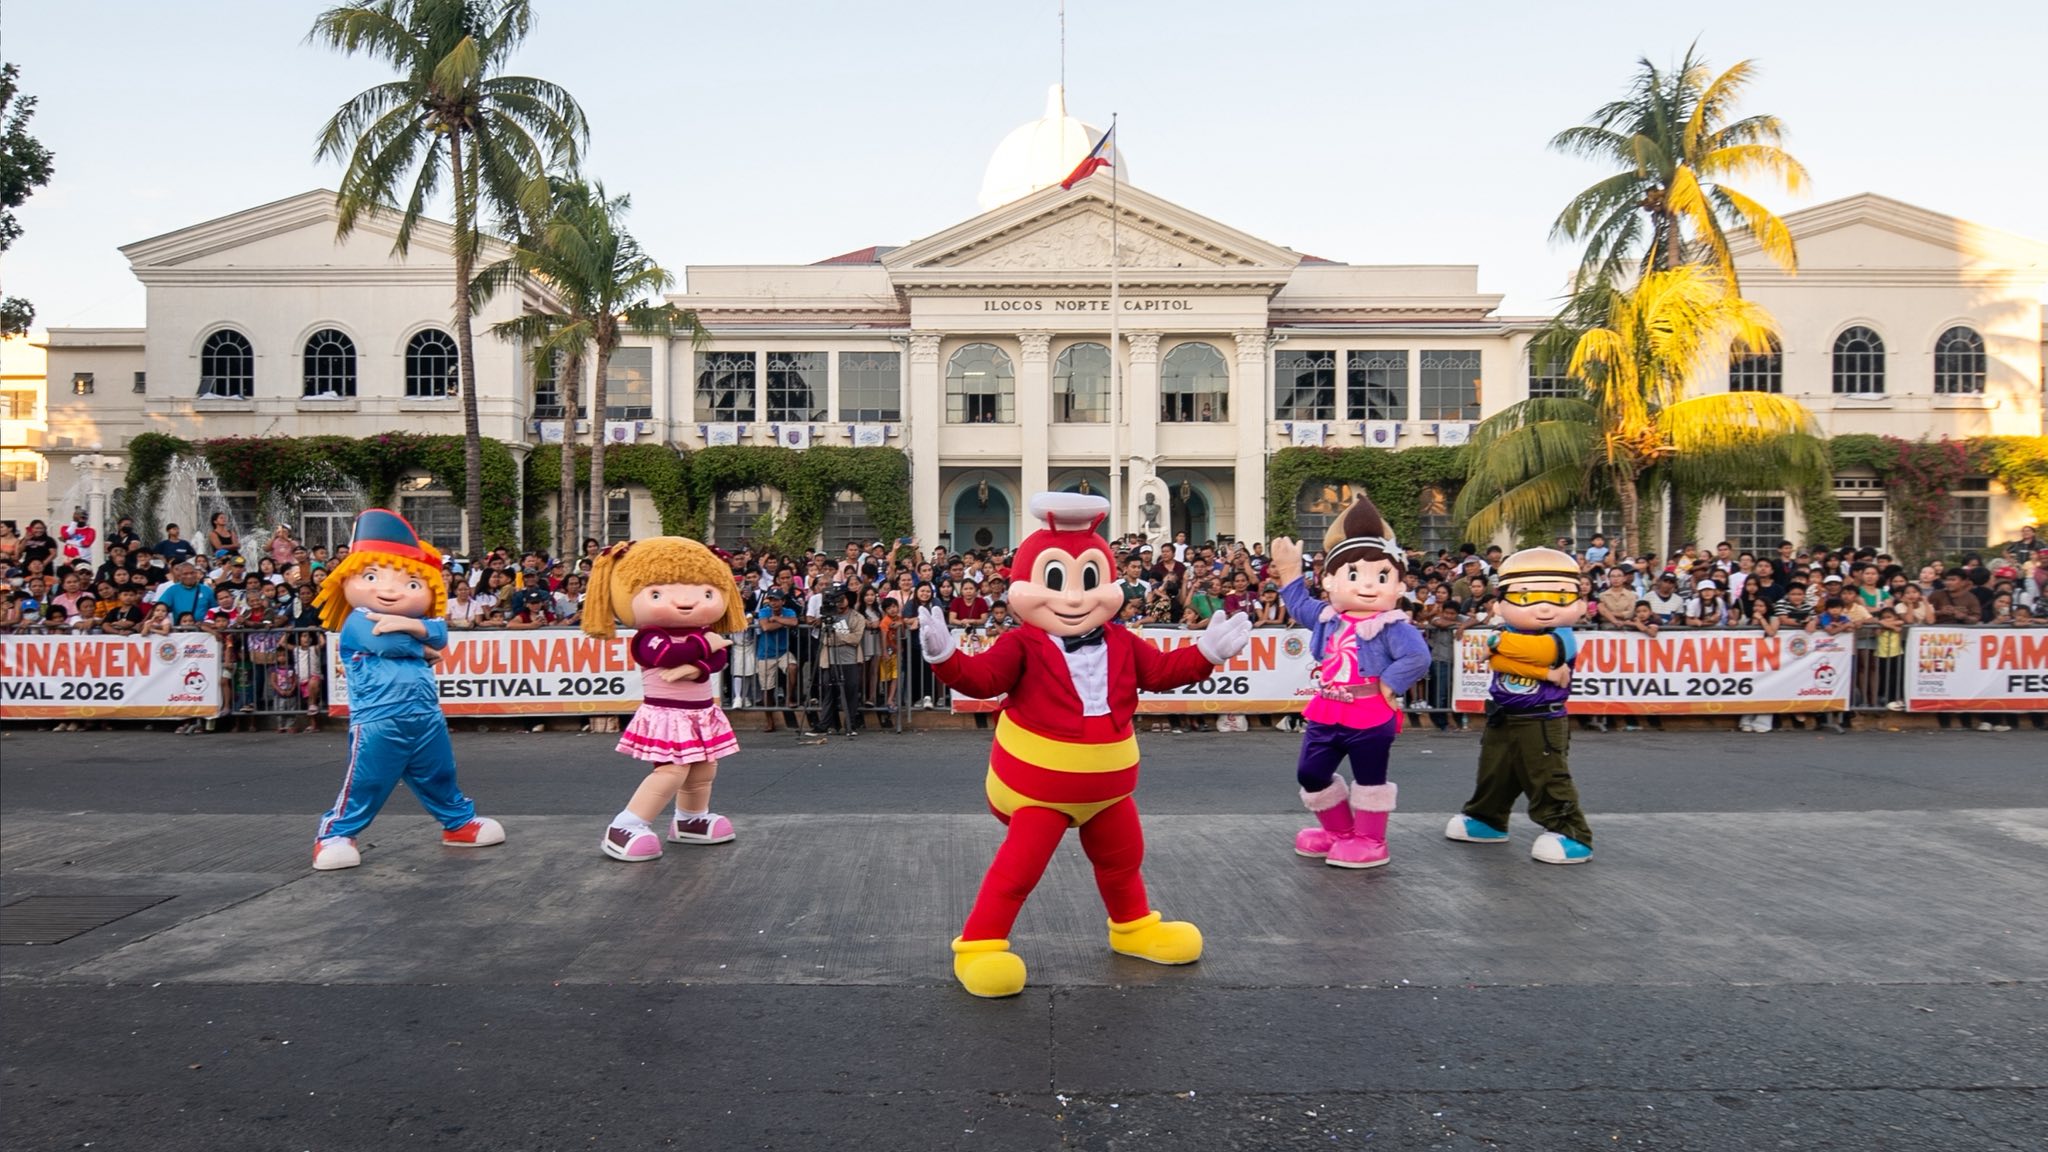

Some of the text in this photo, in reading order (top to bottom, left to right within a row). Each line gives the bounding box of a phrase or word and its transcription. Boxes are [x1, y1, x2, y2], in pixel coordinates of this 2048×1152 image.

[984, 300, 1193, 311] ILOCOS NORTE CAPITOL
[60, 682, 125, 701] 2026
[436, 676, 625, 698] ESTIVAL 2026
[1686, 677, 1753, 696] 2026
[1797, 687, 1833, 696] Jollibee
[167, 693, 203, 702] Jollibee
